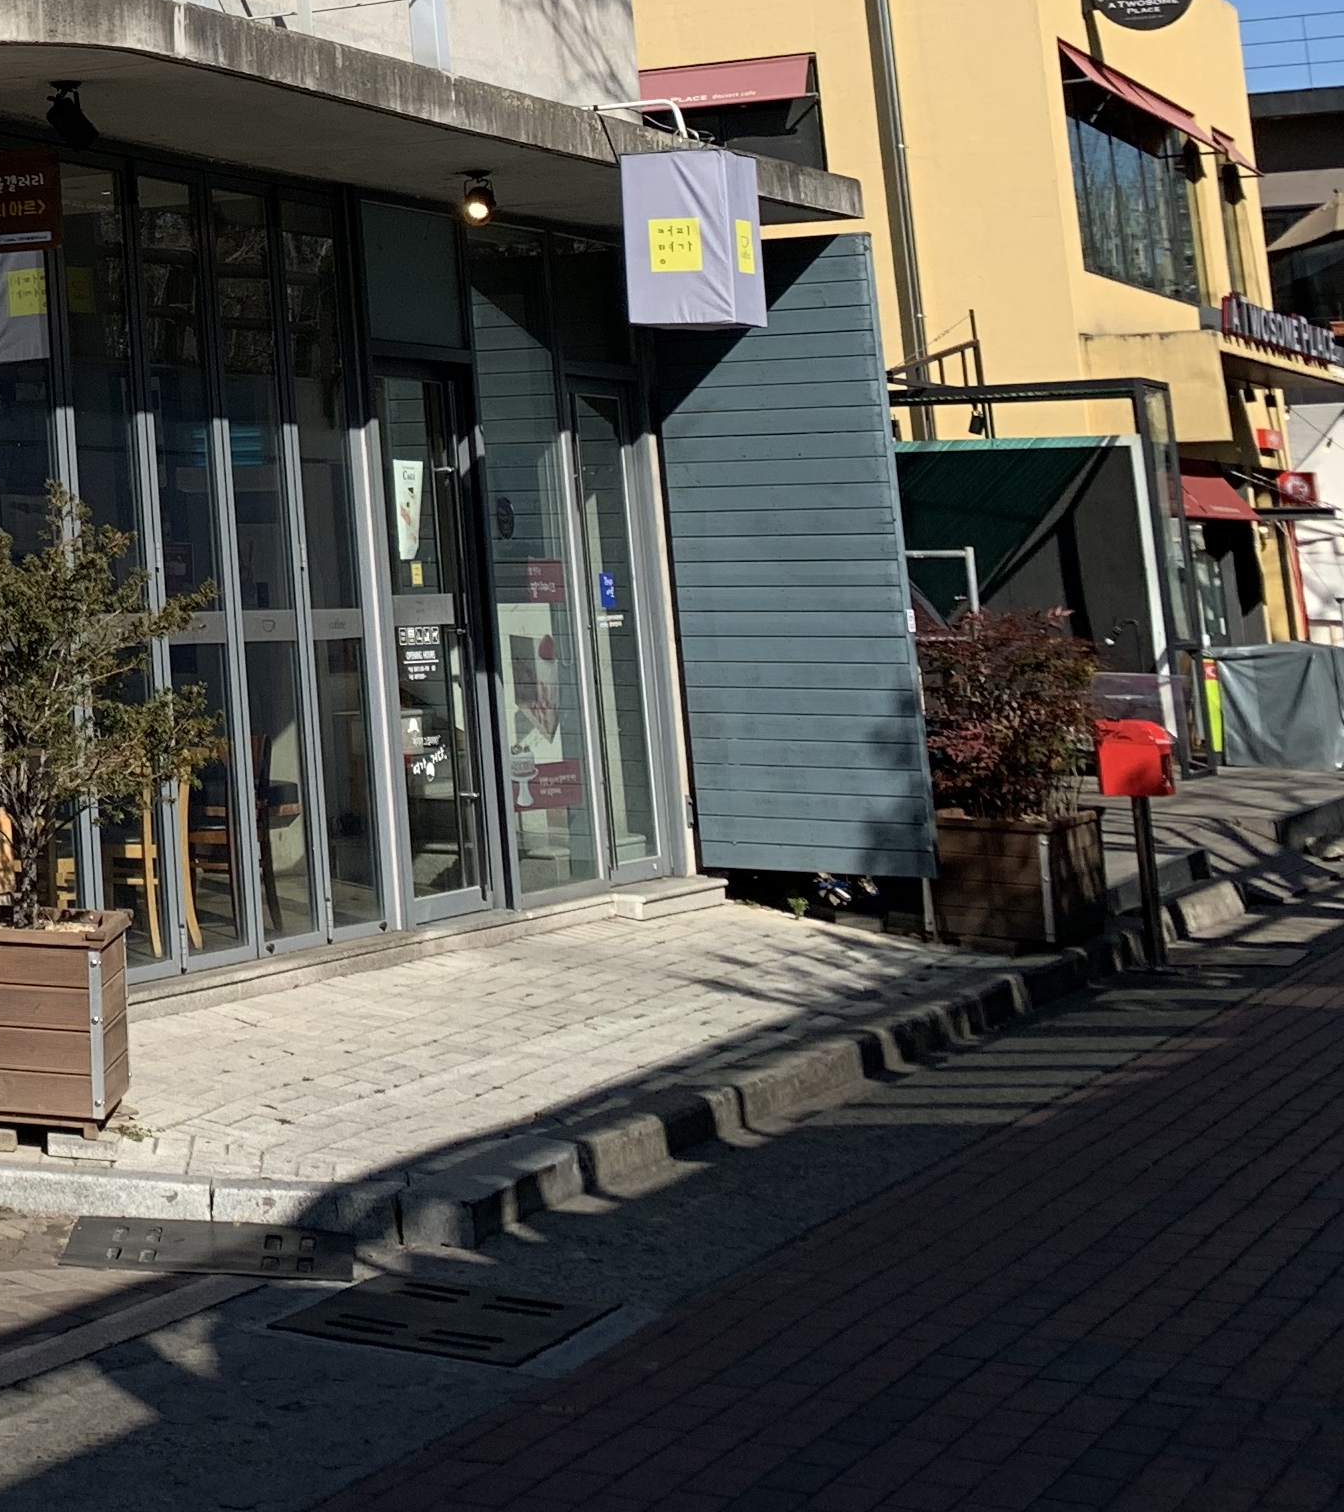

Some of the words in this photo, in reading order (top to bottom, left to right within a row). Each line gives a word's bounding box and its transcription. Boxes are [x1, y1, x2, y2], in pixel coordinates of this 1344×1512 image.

[1126, 6, 1161, 14] PLACE
[670, 93, 708, 103] PLACE
[712, 92, 739, 100] dessert
[657, 224, 691, 237] 커피
[1241, 296, 1302, 349] TWOSOME
[1298, 314, 1338, 362] PLACE
